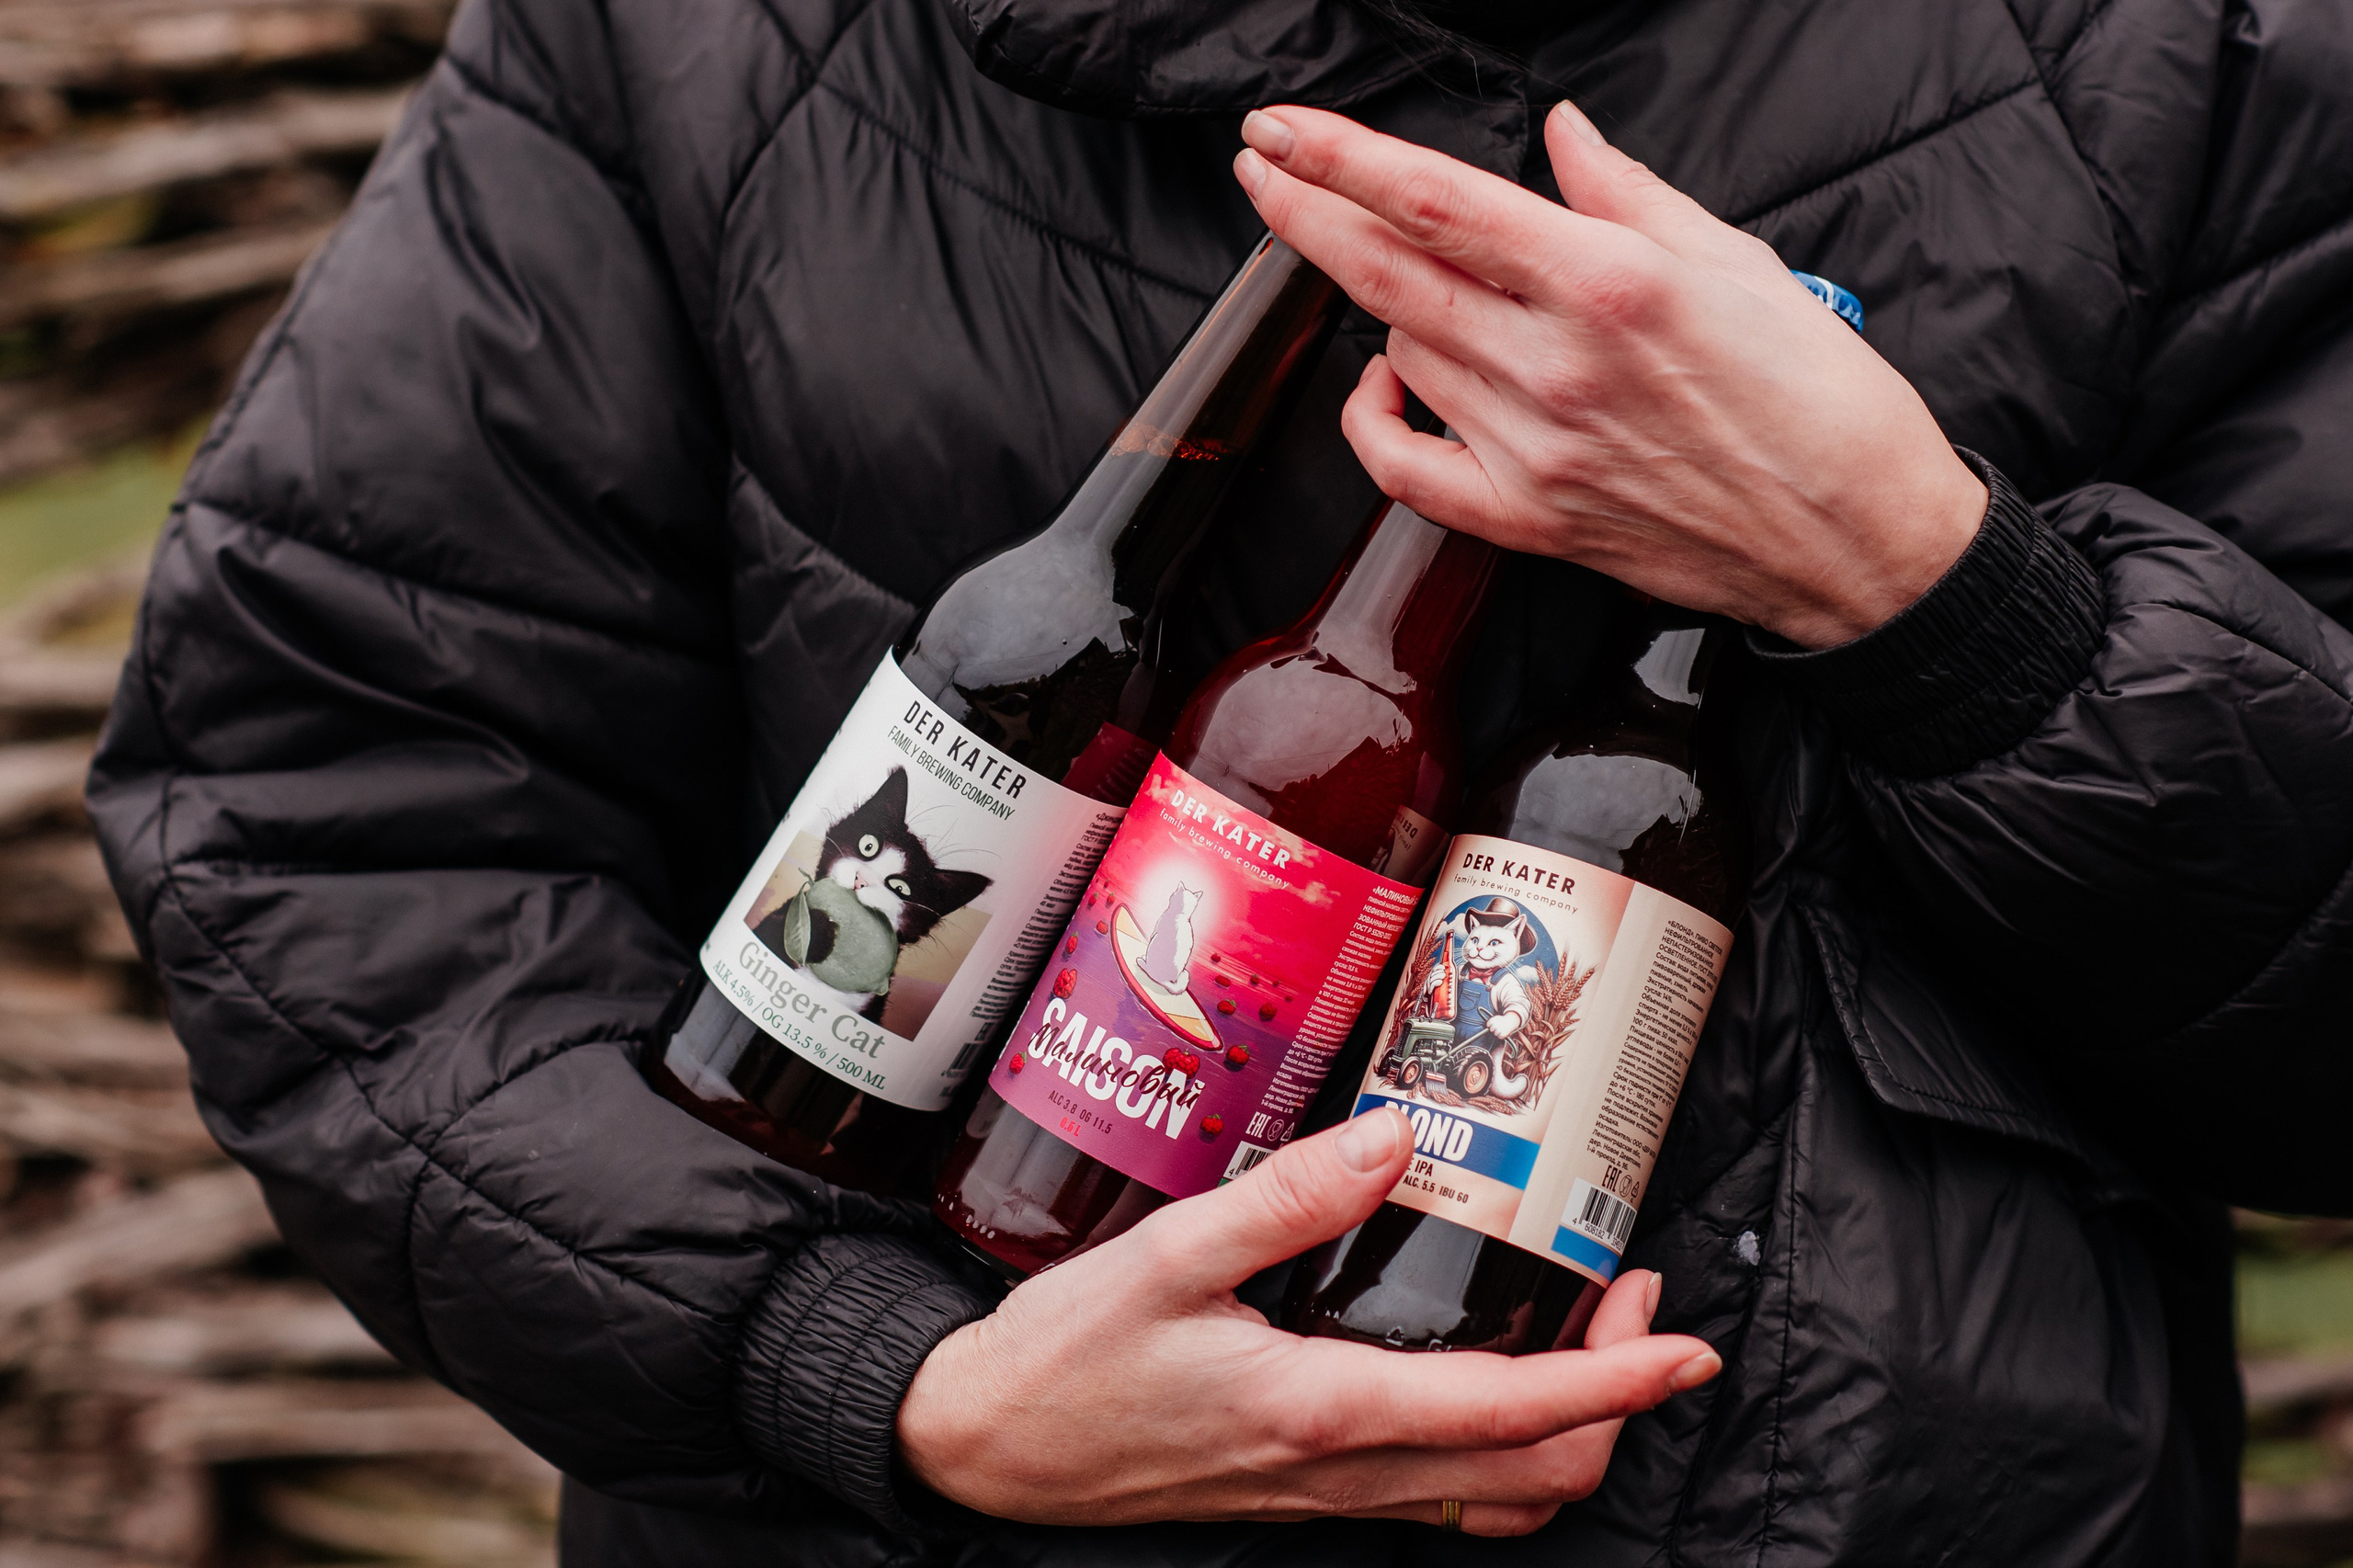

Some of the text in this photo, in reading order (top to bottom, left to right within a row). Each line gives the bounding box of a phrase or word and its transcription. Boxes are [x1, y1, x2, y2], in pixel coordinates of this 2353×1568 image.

[888, 725, 1015, 820] FAMILY BREWING COMPANY
[904, 700, 1026, 799] DER KATER
[1160, 808, 1290, 890] family brewing company
[1171, 790, 1290, 869] DER KATER
[1454, 874, 1578, 915] family brewing company
[1462, 853, 1575, 894] DER KATER
[1655, 952, 1677, 967] Состав:
[1695, 932, 1709, 945] ПИВО
[713, 960, 733, 983] ALK
[730, 980, 756, 1006] 4.5%
[762, 1007, 783, 1028] OG
[782, 1025, 813, 1049] 13.5
[837, 1058, 862, 1077] 500
[862, 1070, 886, 1090] ML
[739, 942, 885, 1058] Ginger Cat
[1028, 1023, 1205, 1110] Малиновый
[1028, 997, 1205, 1140] SAISON
[1048, 1091, 1112, 1133] ALC 3.8 OG 11.5
[1385, 1101, 1473, 1162] OND
[1403, 1175, 1469, 1203] ALC. 5.5 IBU 60
[1415, 1160, 1433, 1176] IPA
